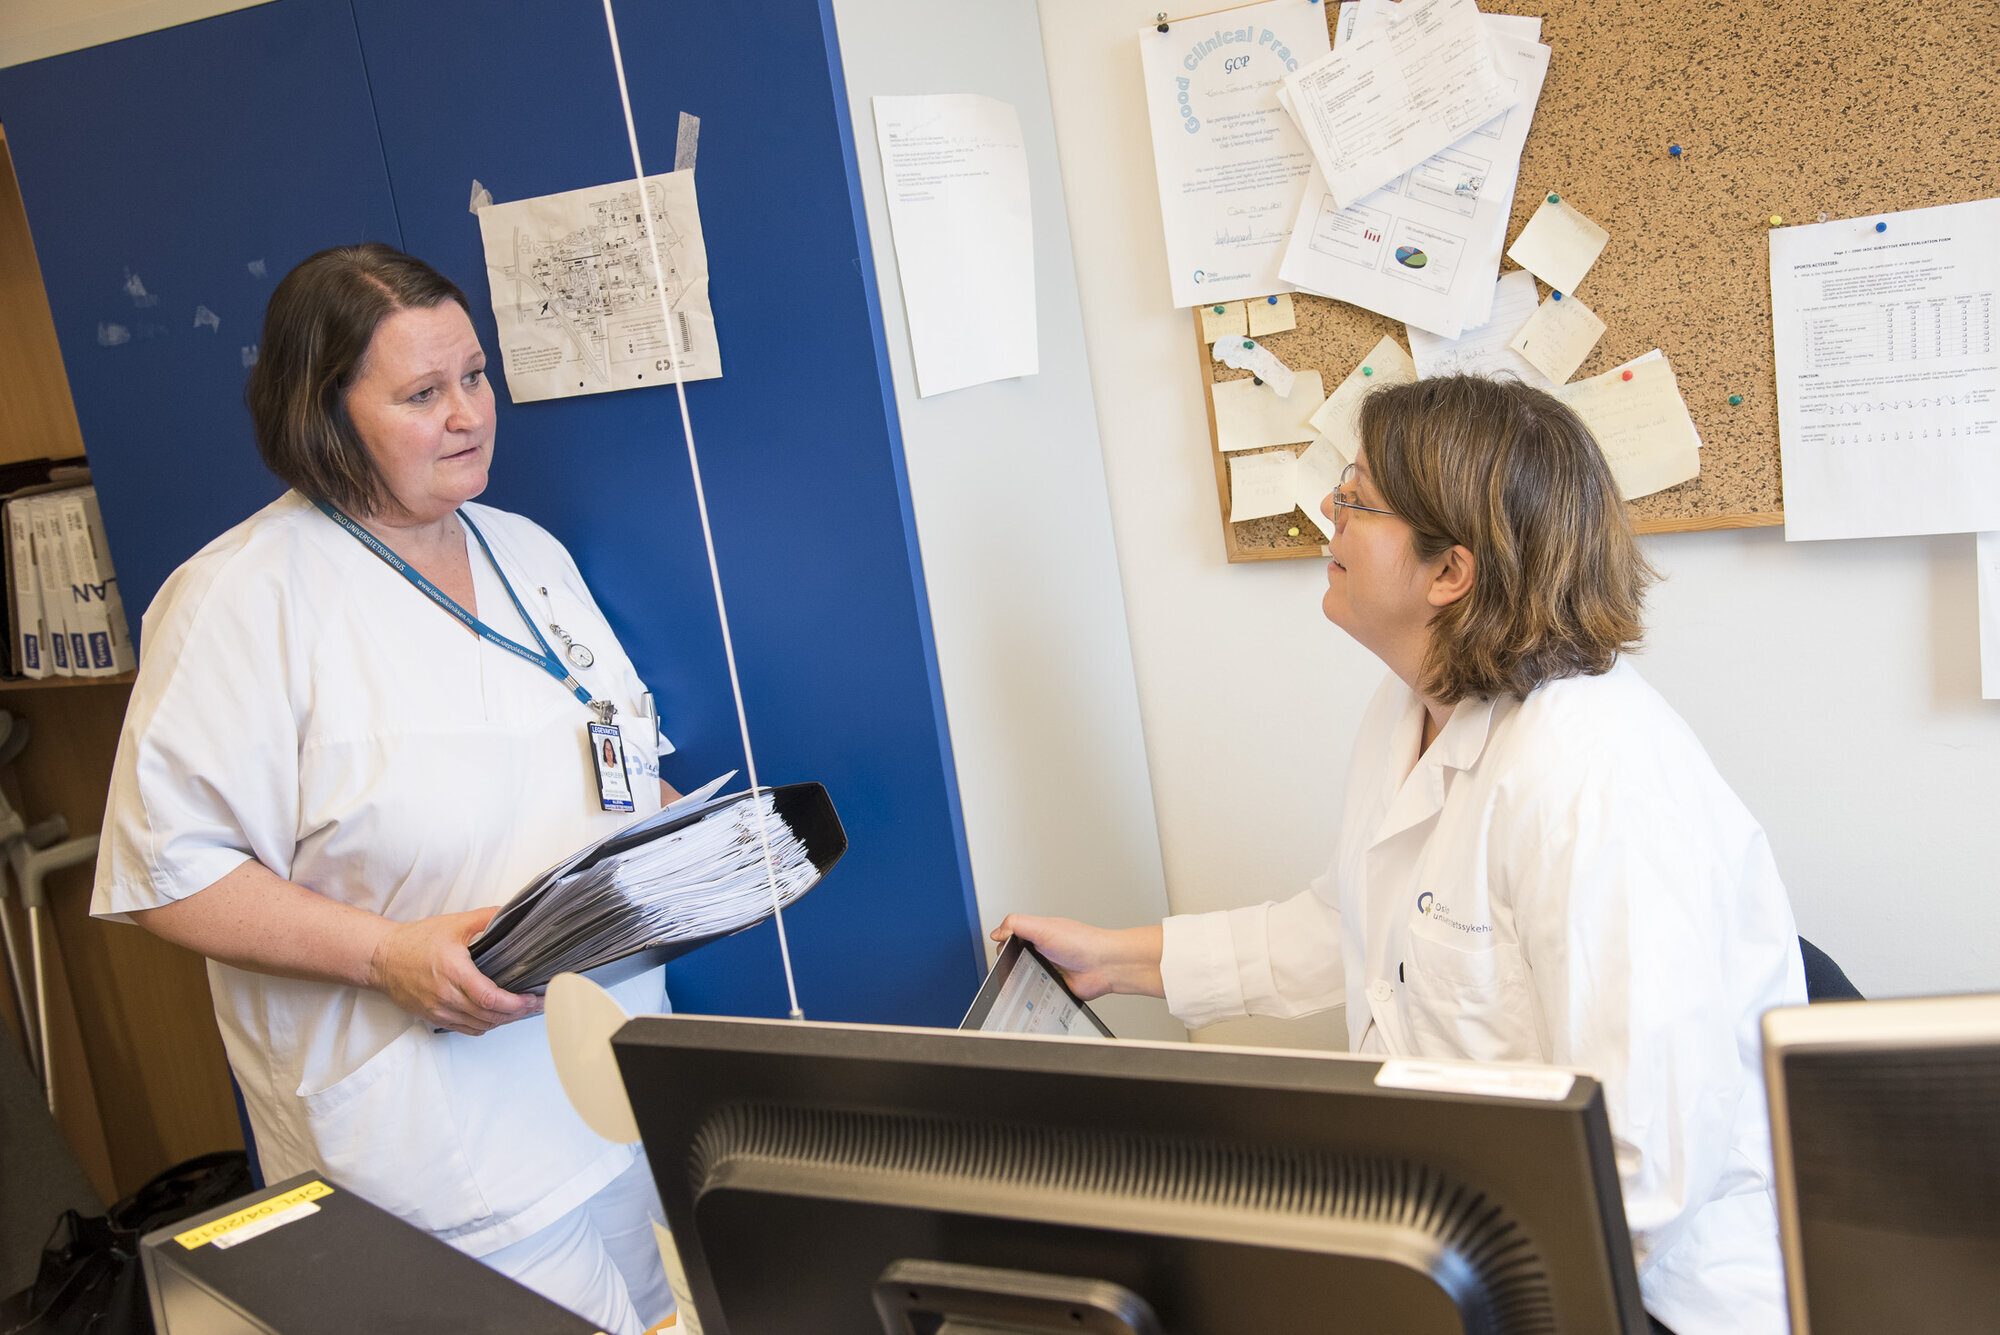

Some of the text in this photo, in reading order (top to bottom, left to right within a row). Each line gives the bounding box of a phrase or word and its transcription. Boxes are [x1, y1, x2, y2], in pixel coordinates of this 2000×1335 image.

[1184, 26, 1253, 70] Clinical
[1224, 55, 1250, 74] GCP
[1176, 76, 1200, 134] Good
[332, 511, 406, 572] OSLO UNIVERSITETSSYKEHUS
[72, 578, 116, 603] AN
[281, 1185, 324, 1205] OPL
